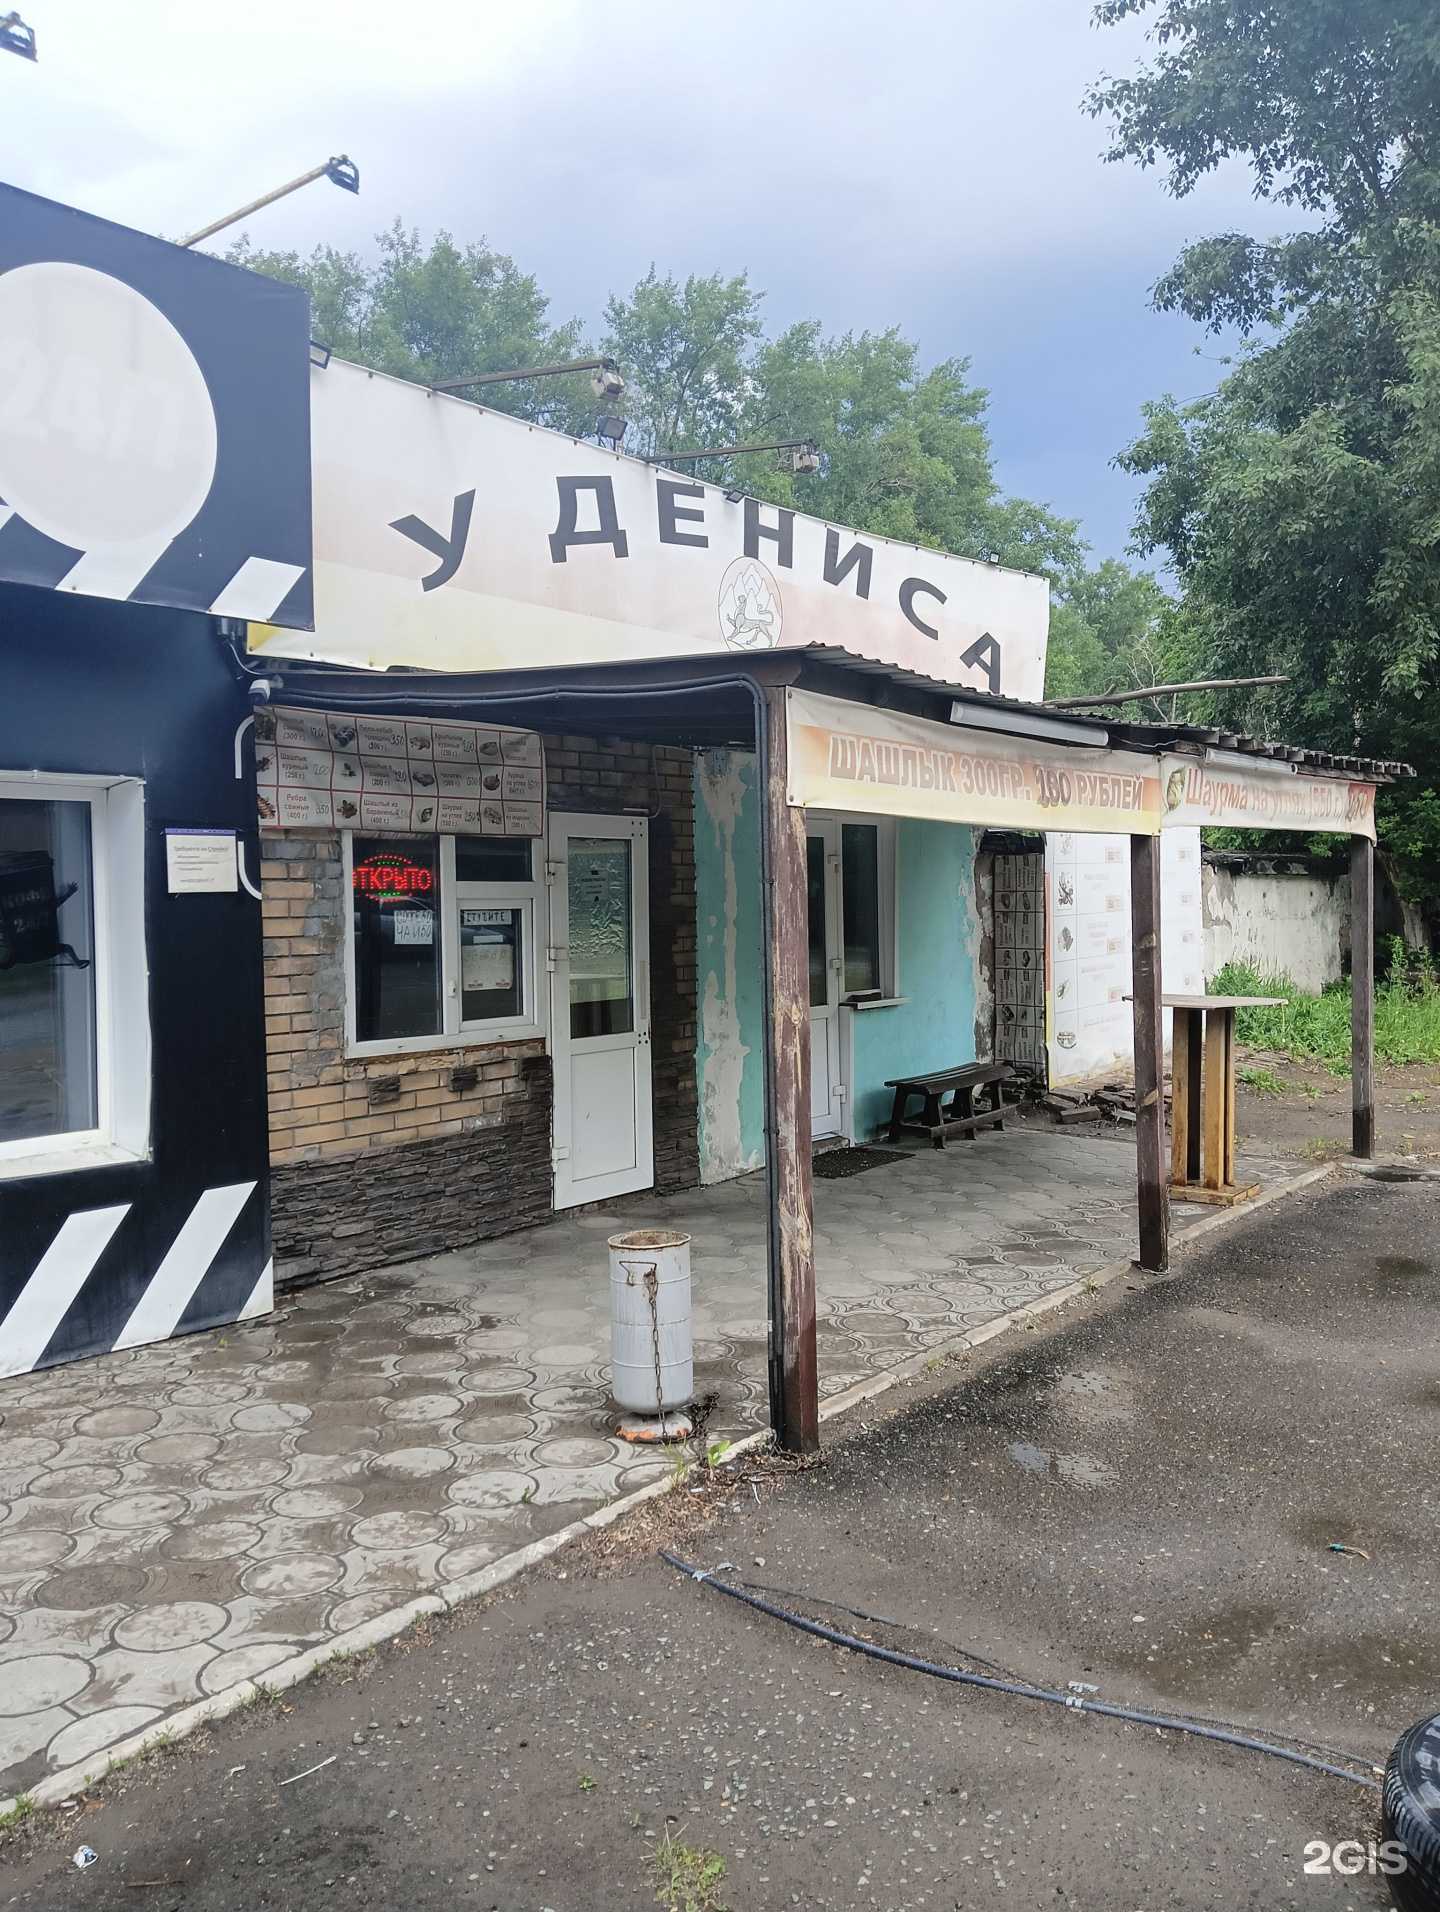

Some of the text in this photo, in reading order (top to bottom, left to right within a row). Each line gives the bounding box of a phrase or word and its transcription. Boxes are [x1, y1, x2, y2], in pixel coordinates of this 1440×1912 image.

[388, 474, 1003, 694] У ДЕНИСА
[828, 732, 956, 792] ШАШЛЫК
[1075, 771, 1144, 811] РУБЛЕЙ
[1186, 768, 1248, 817] Шаурма
